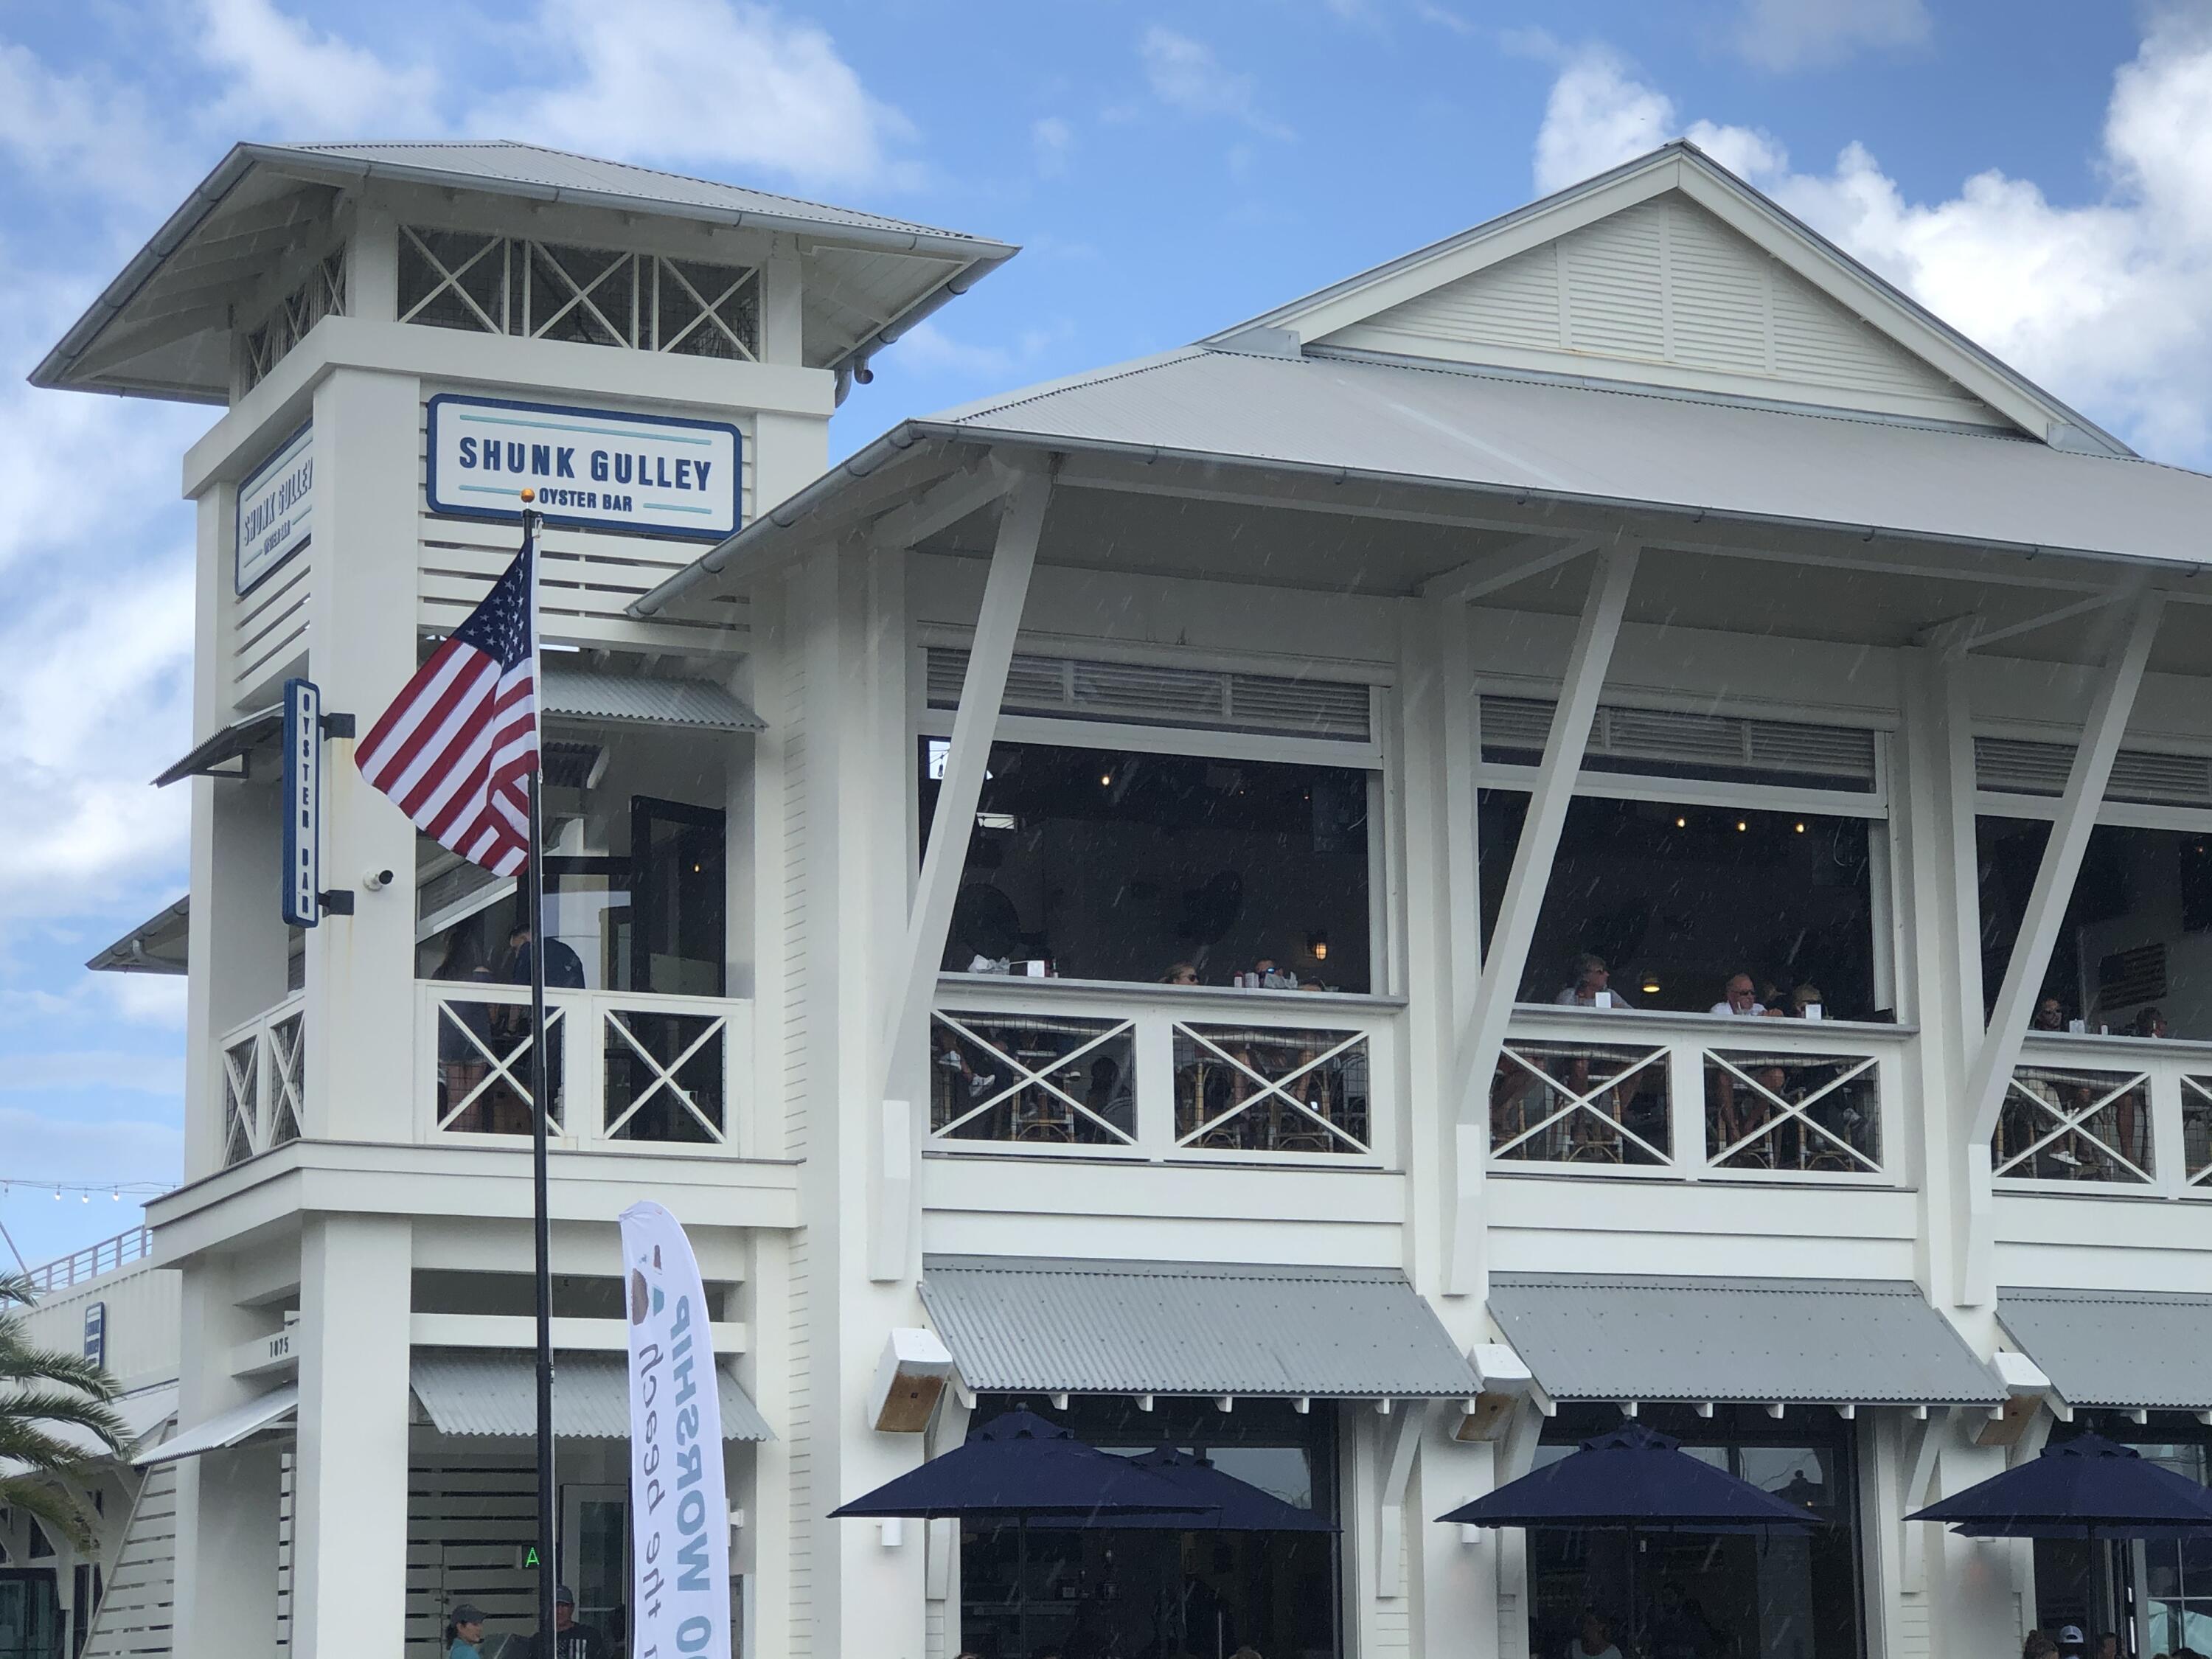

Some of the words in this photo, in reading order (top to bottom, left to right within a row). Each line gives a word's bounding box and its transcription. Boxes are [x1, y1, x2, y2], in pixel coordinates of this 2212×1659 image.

[459, 437, 574, 479] SHUNK
[591, 451, 712, 491] GULLEY
[245, 491, 275, 546] SHUNK
[539, 487, 597, 509] OYSTER
[602, 493, 633, 512] BAR
[302, 693, 310, 829] OYSTER
[302, 848, 310, 914] BAR
